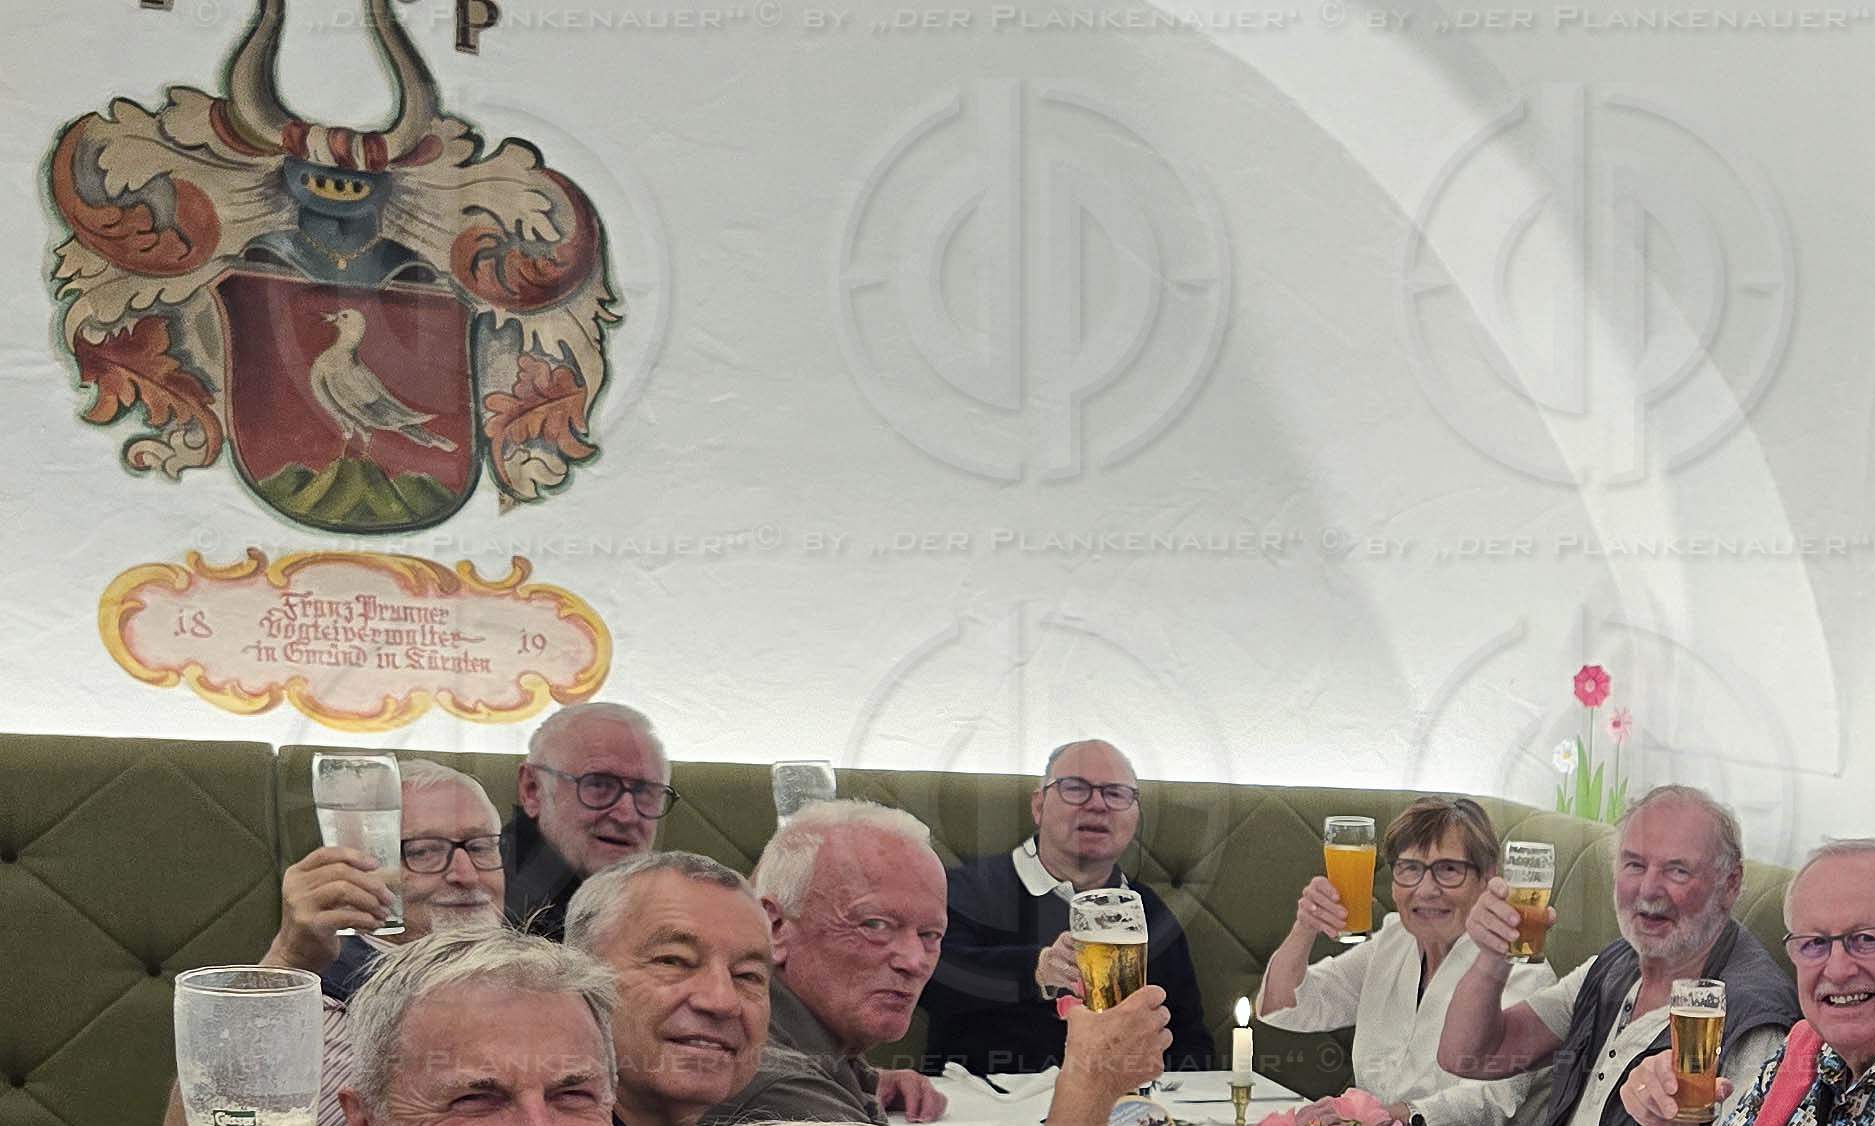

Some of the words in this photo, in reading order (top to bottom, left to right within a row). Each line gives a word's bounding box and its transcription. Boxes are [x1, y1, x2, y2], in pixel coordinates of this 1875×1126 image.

[267, 590, 354, 623] Franz
[284, 641, 368, 668] Gmünd
[376, 647, 400, 669] in
